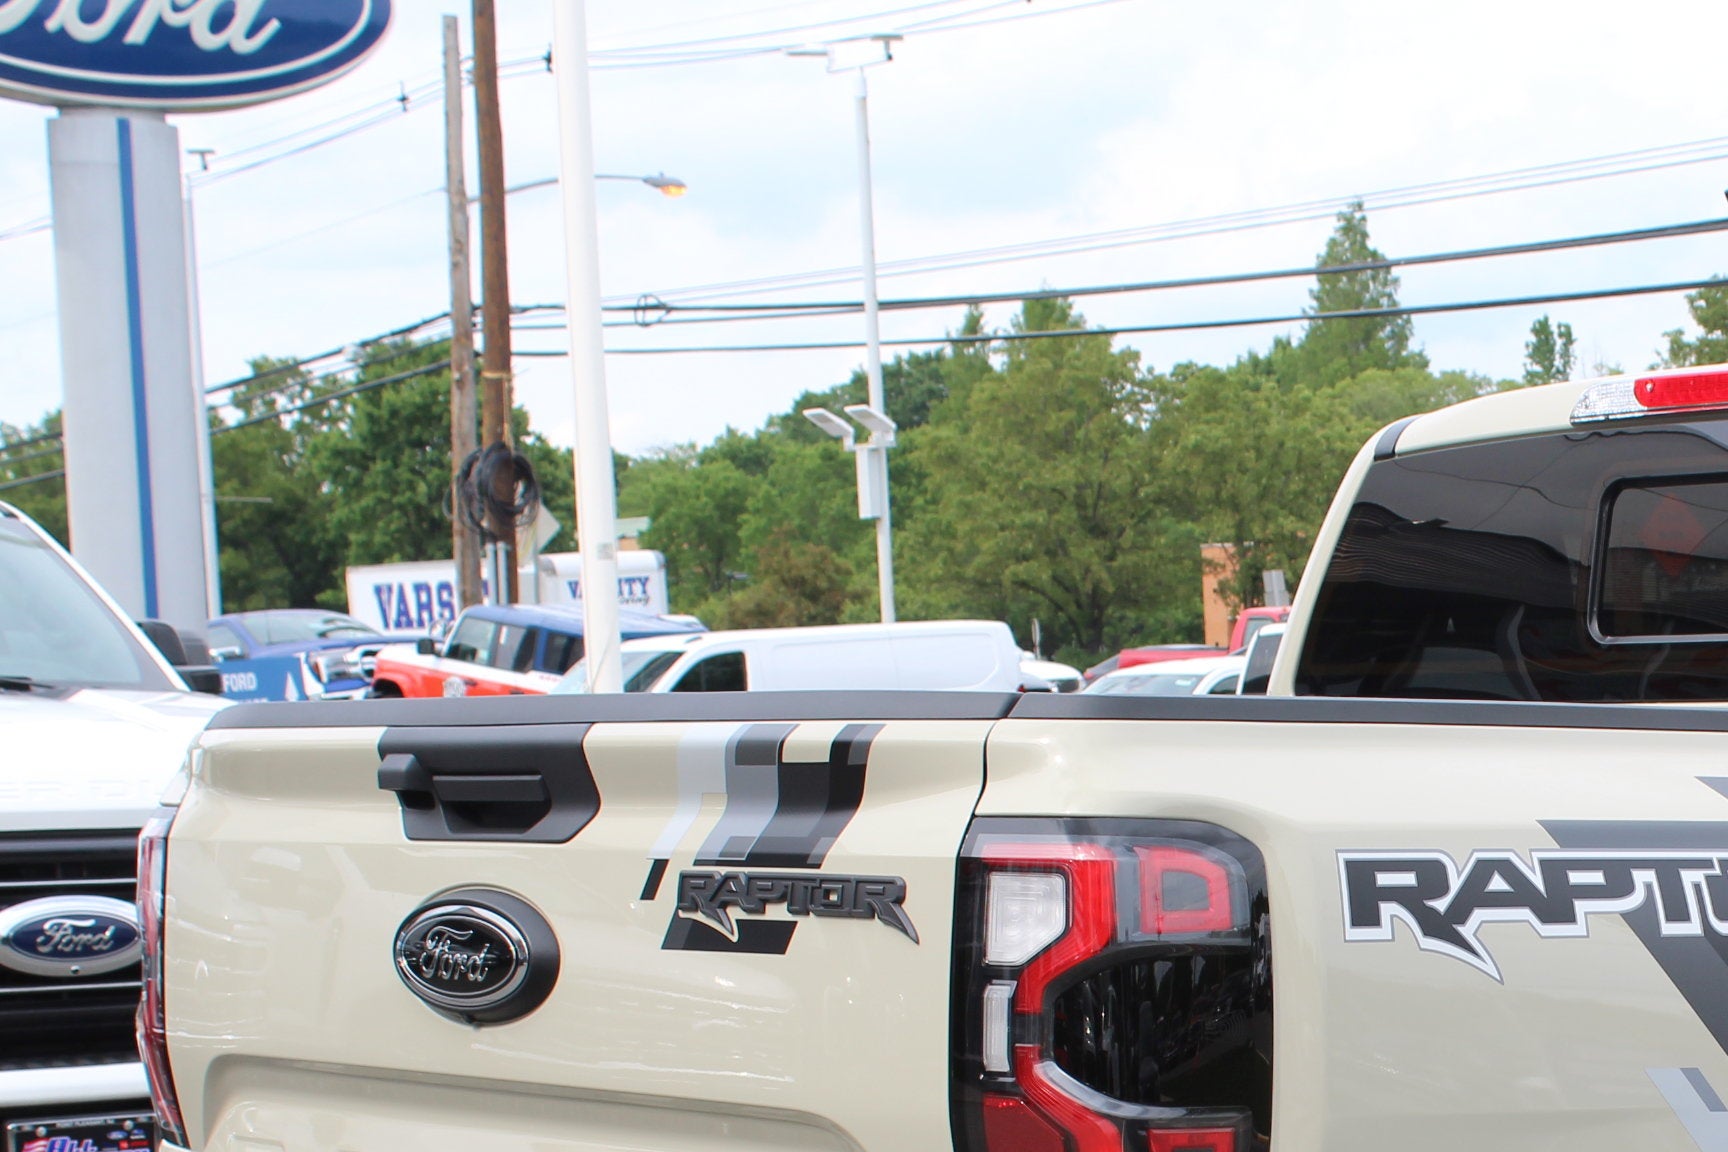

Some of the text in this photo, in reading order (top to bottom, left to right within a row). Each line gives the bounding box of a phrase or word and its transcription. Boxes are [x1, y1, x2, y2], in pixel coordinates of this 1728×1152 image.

[0, 0, 281, 54] ord
[222, 671, 257, 692] FORD
[678, 869, 920, 944] RAPTOR
[36, 918, 113, 953] Ford
[421, 926, 491, 983] Ford
